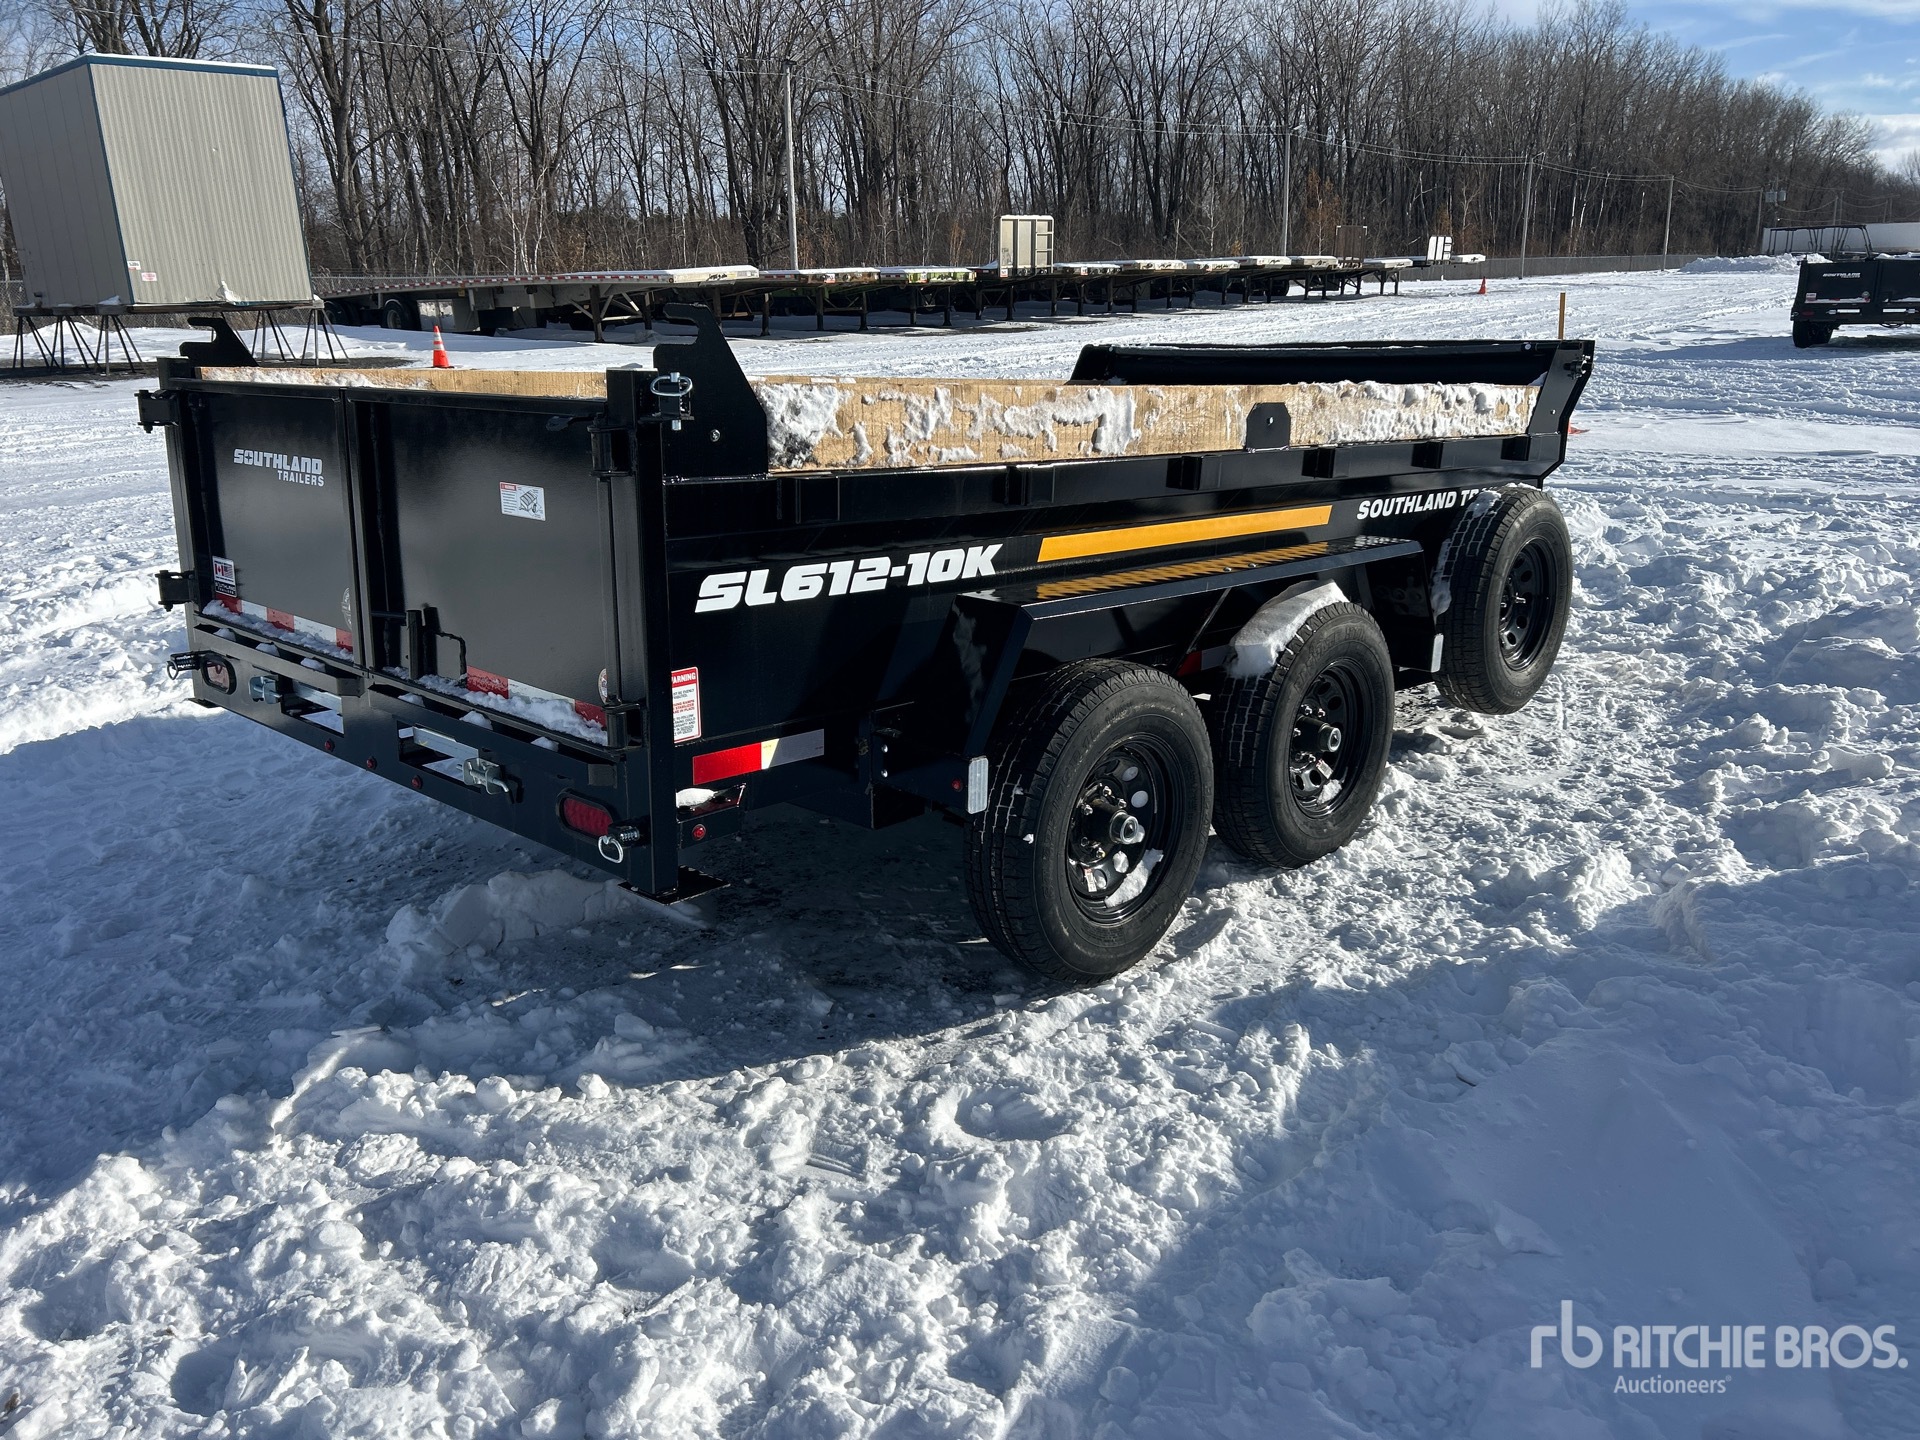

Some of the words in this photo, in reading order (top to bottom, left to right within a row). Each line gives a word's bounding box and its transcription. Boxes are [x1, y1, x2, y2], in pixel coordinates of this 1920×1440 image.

[233, 448, 323, 475] SOUTHLAND
[277, 470, 325, 487] TRAILERS
[1356, 491, 1458, 520] SOUTHLAND
[694, 543, 1004, 613] SL612-10K
